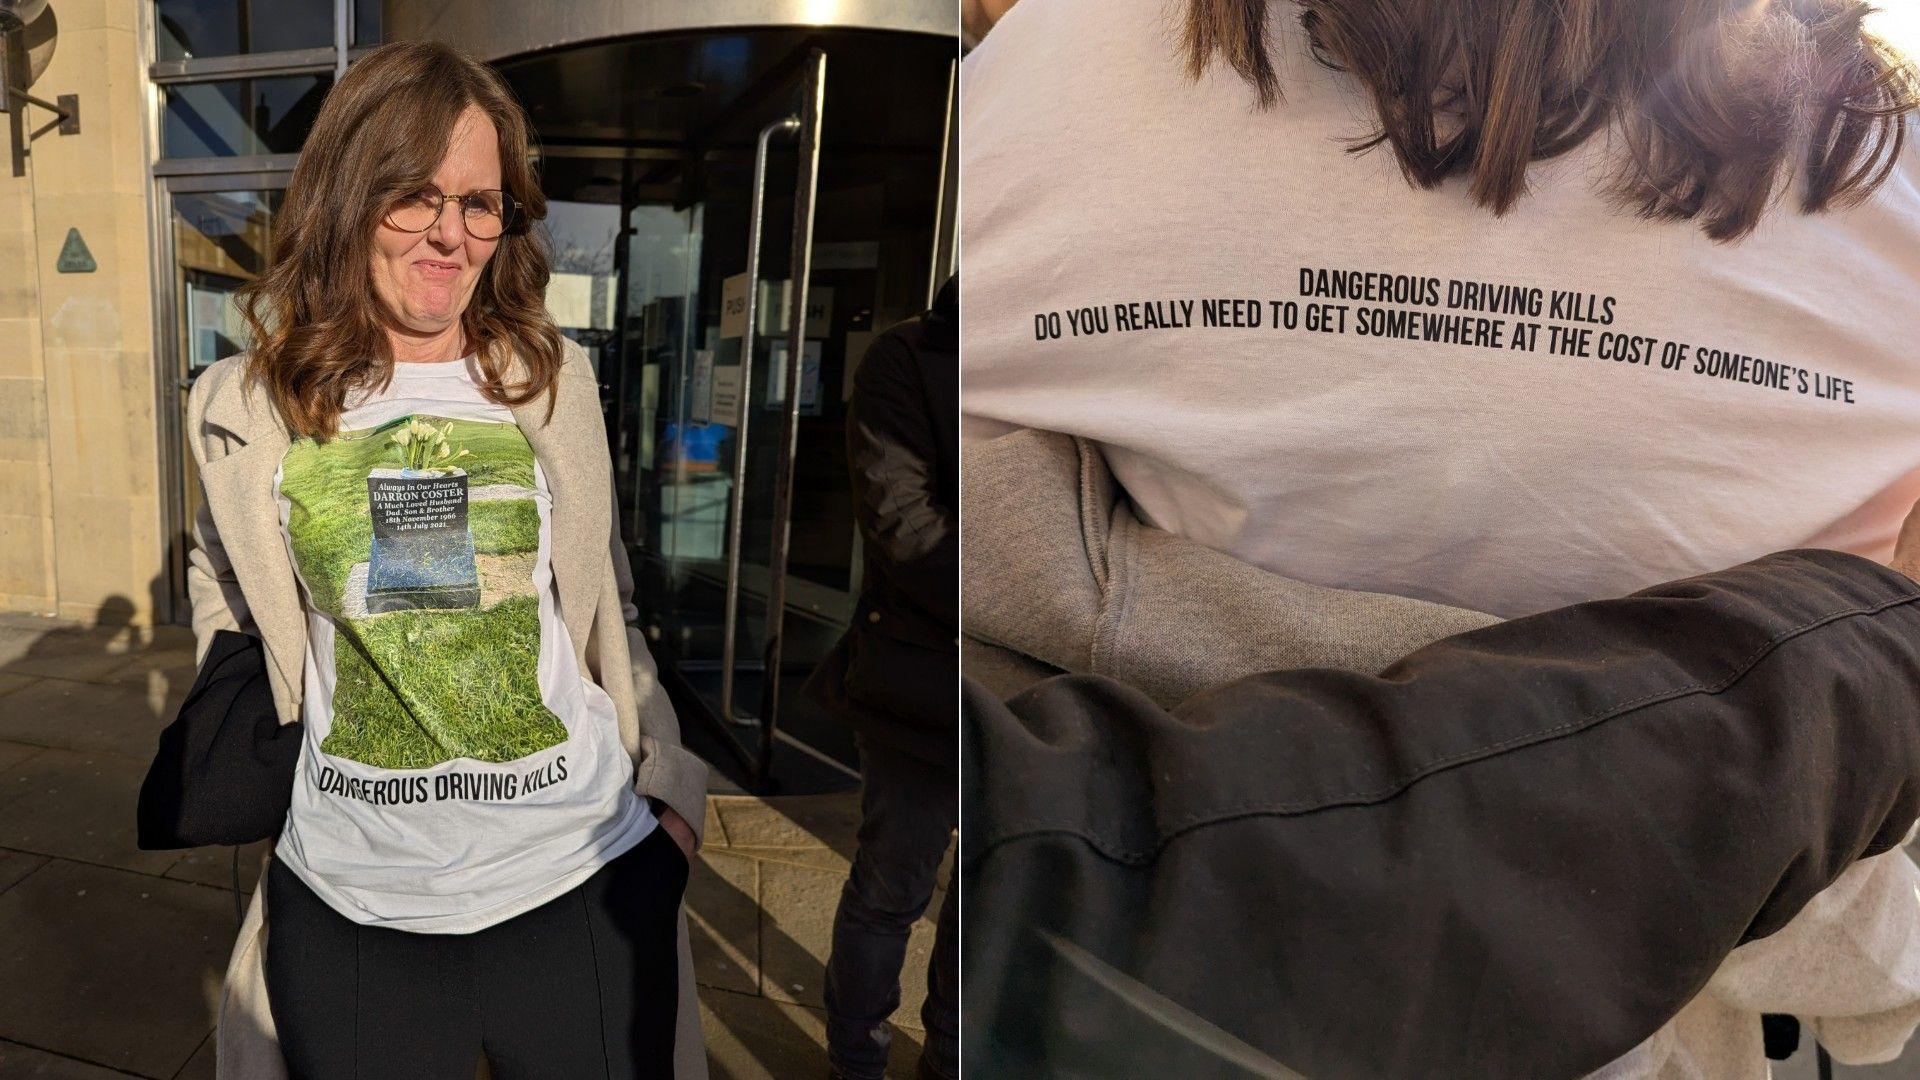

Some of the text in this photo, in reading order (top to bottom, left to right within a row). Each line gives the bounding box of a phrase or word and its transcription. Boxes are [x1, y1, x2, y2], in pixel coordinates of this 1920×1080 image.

[1299, 267, 1615, 326] DANGEROUS DRIVING KILLS
[1034, 299, 1855, 404] DO YOU REALLY NEED TO GET SOMEWHERE AT THE COST OF SOMEONE'S LIFE
[378, 483, 406, 492] Always
[433, 481, 459, 490] Hearts
[373, 488, 464, 501] DARRON COSTER
[406, 500, 428, 508] Loved
[429, 497, 462, 506] Husband
[426, 505, 455, 514] Brother
[386, 516, 401, 524] 18th
[402, 514, 439, 523] November
[397, 523, 412, 531] 14th
[413, 522, 429, 530] July
[318, 755, 568, 806] DANGEROUS DRIVING KILLS
